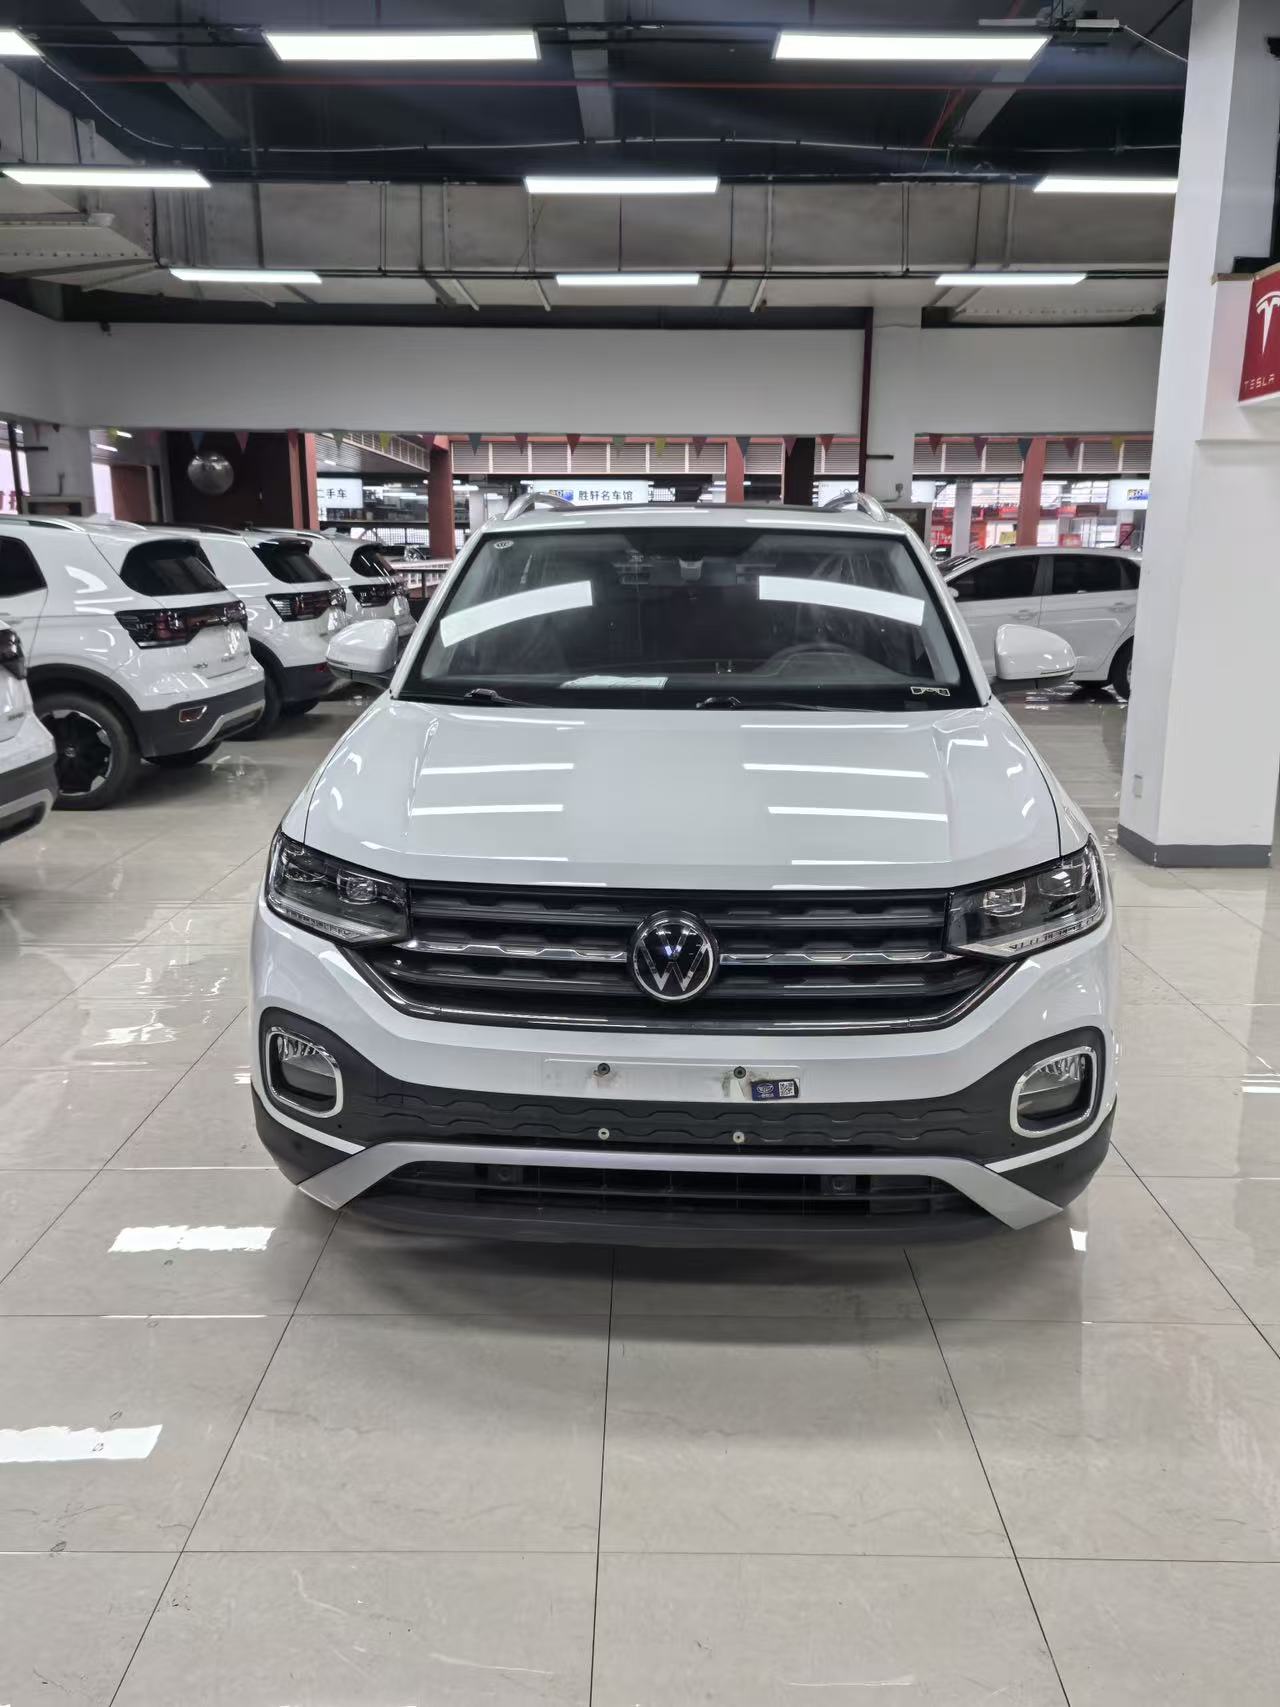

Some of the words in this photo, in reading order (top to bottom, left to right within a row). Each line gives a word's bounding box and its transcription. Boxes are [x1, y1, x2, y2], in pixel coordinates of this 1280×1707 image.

[1243, 373, 1275, 392] TESLA
[578, 490, 633, 501] 胜轩名车馆
